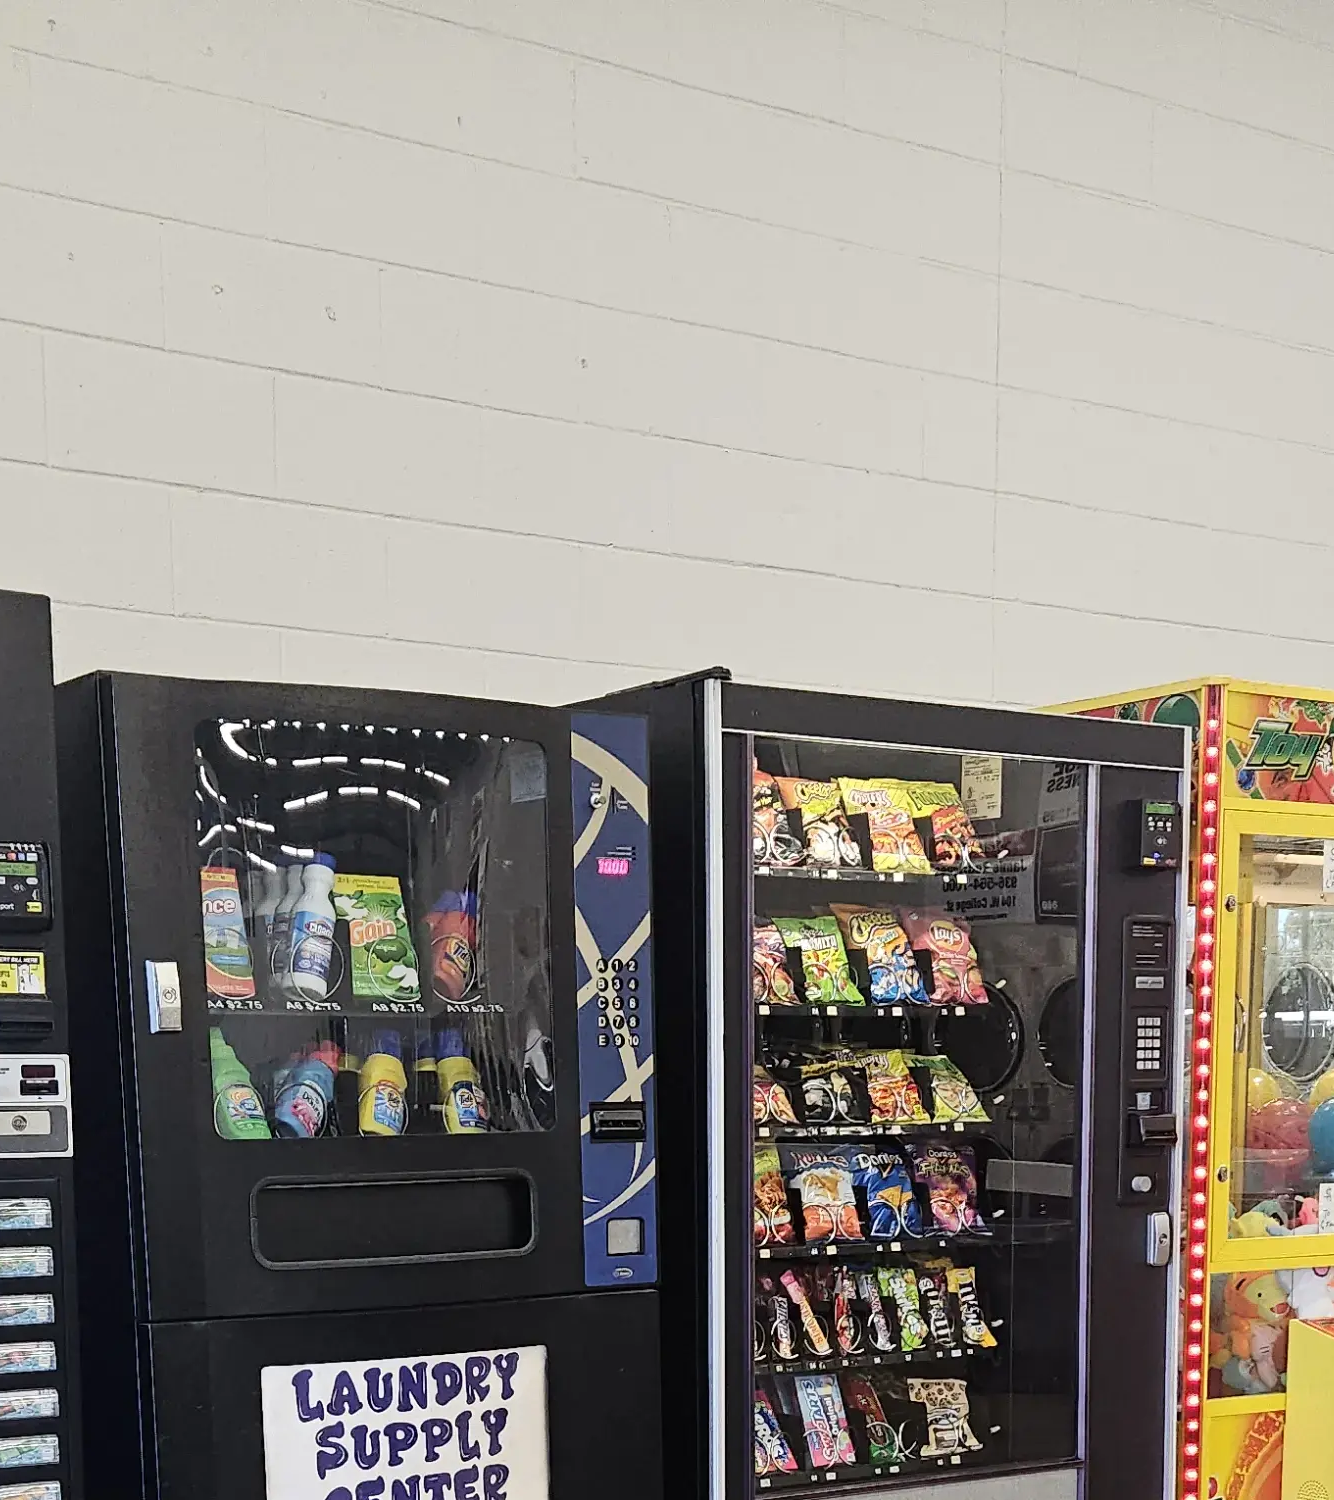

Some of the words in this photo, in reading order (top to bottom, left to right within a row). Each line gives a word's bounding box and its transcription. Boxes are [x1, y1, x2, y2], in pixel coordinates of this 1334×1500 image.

[1245, 718, 1323, 781] Toy
[349, 919, 397, 946] Gain
[597, 961, 605, 970] A
[614, 961, 619, 970] 1
[628, 961, 635, 970] 2
[598, 980, 605, 989] B
[614, 980, 620, 989] 3
[628, 980, 635, 989] 4
[207, 1000, 224, 1009] A4
[227, 1000, 263, 1010] $2.75
[305, 1001, 341, 1012] $2.75
[598, 998, 606, 1007] C
[614, 998, 621, 1007] 5
[629, 998, 636, 1007] 6
[390, 1003, 424, 1013] $2.75
[447, 1004, 469, 1013] A10
[598, 1017, 605, 1026] D
[615, 1017, 621, 1026] 7
[629, 1017, 636, 1026] 8
[599, 1036, 606, 1045] E
[615, 1036, 621, 1045] 9
[628, 1036, 639, 1045] 10
[292, 1352, 519, 1423] LAUNDRY
[315, 1407, 508, 1480] SUPPLY
